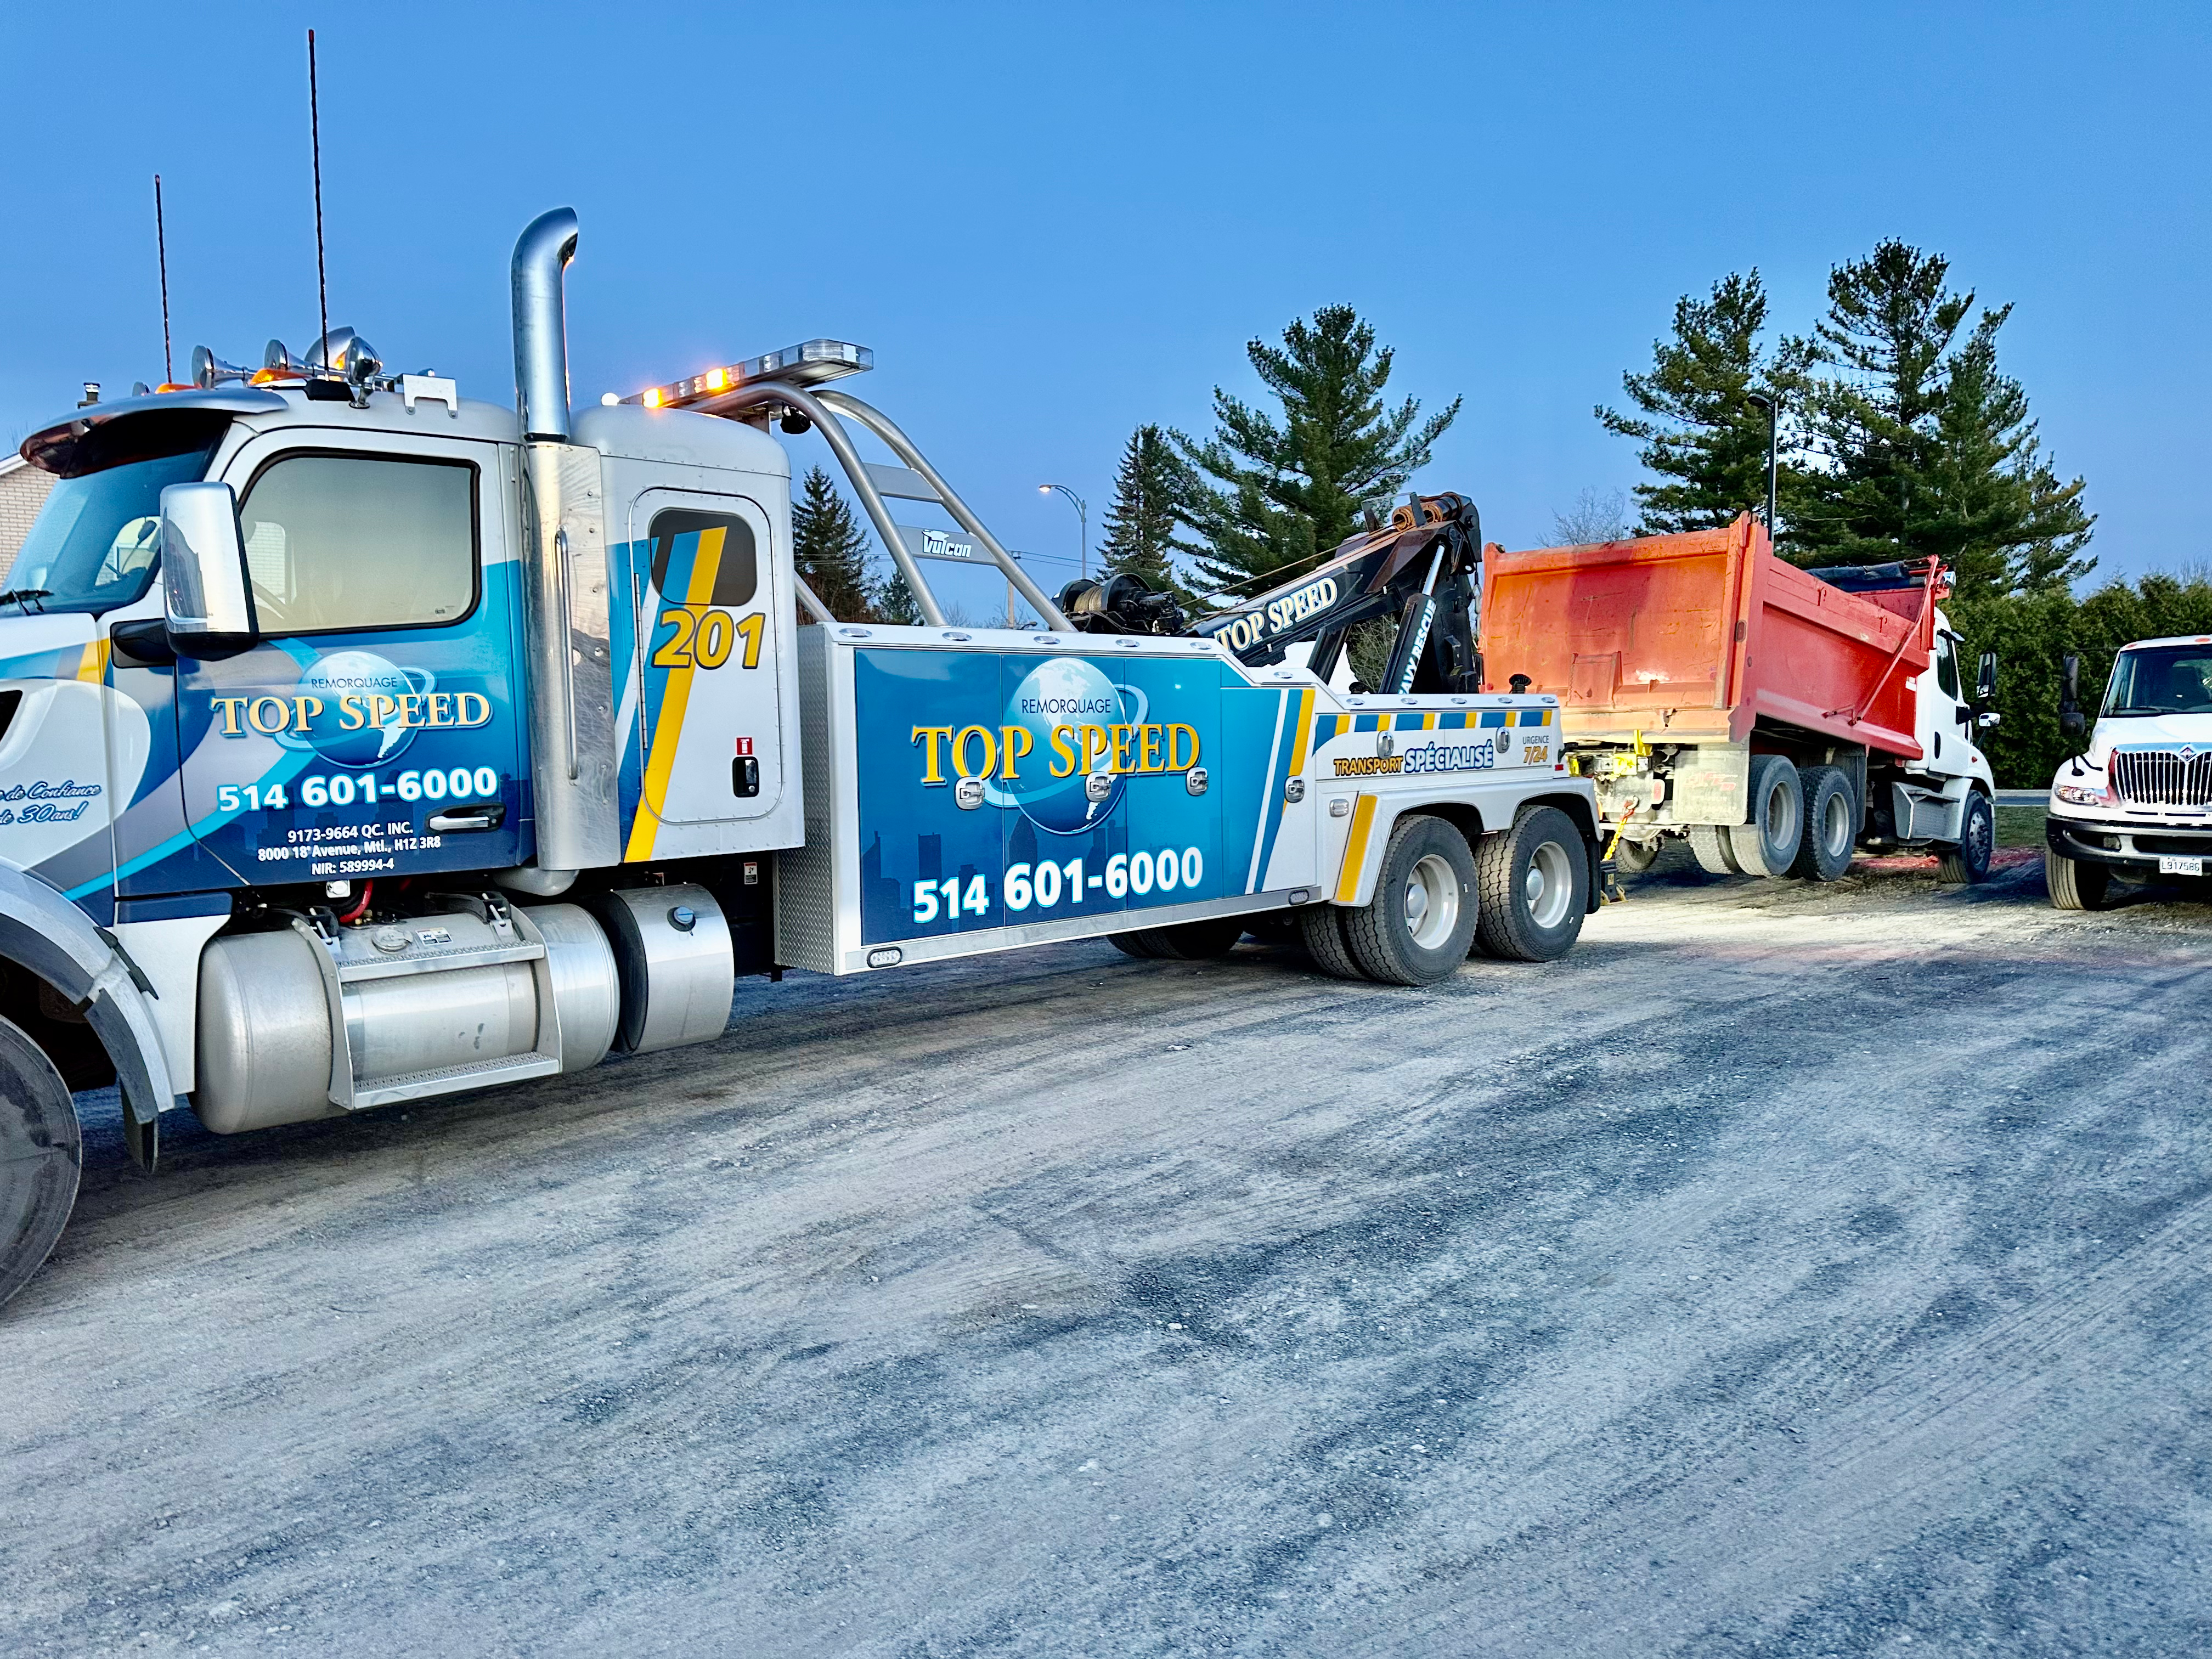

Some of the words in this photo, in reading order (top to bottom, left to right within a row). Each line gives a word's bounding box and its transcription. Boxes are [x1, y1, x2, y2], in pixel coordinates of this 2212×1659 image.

[923, 533, 972, 557] Vulcan
[1214, 611, 1265, 654] TOP
[1268, 577, 1338, 634] SPEED
[651, 607, 766, 670] 201
[1411, 599, 1437, 658] RESCUE
[311, 677, 398, 689] REMORQUAGE
[210, 695, 324, 738] TOP
[338, 692, 493, 731] SPEED
[1022, 698, 1111, 714] REMORQUAGE
[1522, 735, 1549, 744] URGENCE
[911, 724, 1034, 787] TOP
[1049, 723, 1201, 778] SPEED
[1334, 755, 1404, 776] TRANSPORT
[1404, 738, 1494, 774] SPÉCIALISÉ
[1523, 746, 1548, 765] 7/24
[5, 785, 26, 801] de
[27, 780, 102, 799] Confiance
[217, 783, 289, 811] 514
[300, 765, 498, 808] 601-6000
[287, 825, 358, 843] 9173-9664
[361, 823, 384, 838] QC.
[387, 821, 414, 835] INC.
[257, 847, 289, 861] 8000
[312, 845, 362, 857] Avenue,
[364, 839, 392, 854] Mtl.,
[394, 838, 417, 851] H1Z
[419, 836, 441, 849] 3R8
[311, 862, 336, 875] NIR:
[340, 857, 394, 873] 589994-4
[2162, 861, 2200, 871] L917586
[912, 874, 990, 924] 514
[1003, 845, 1204, 912] 601-6000
